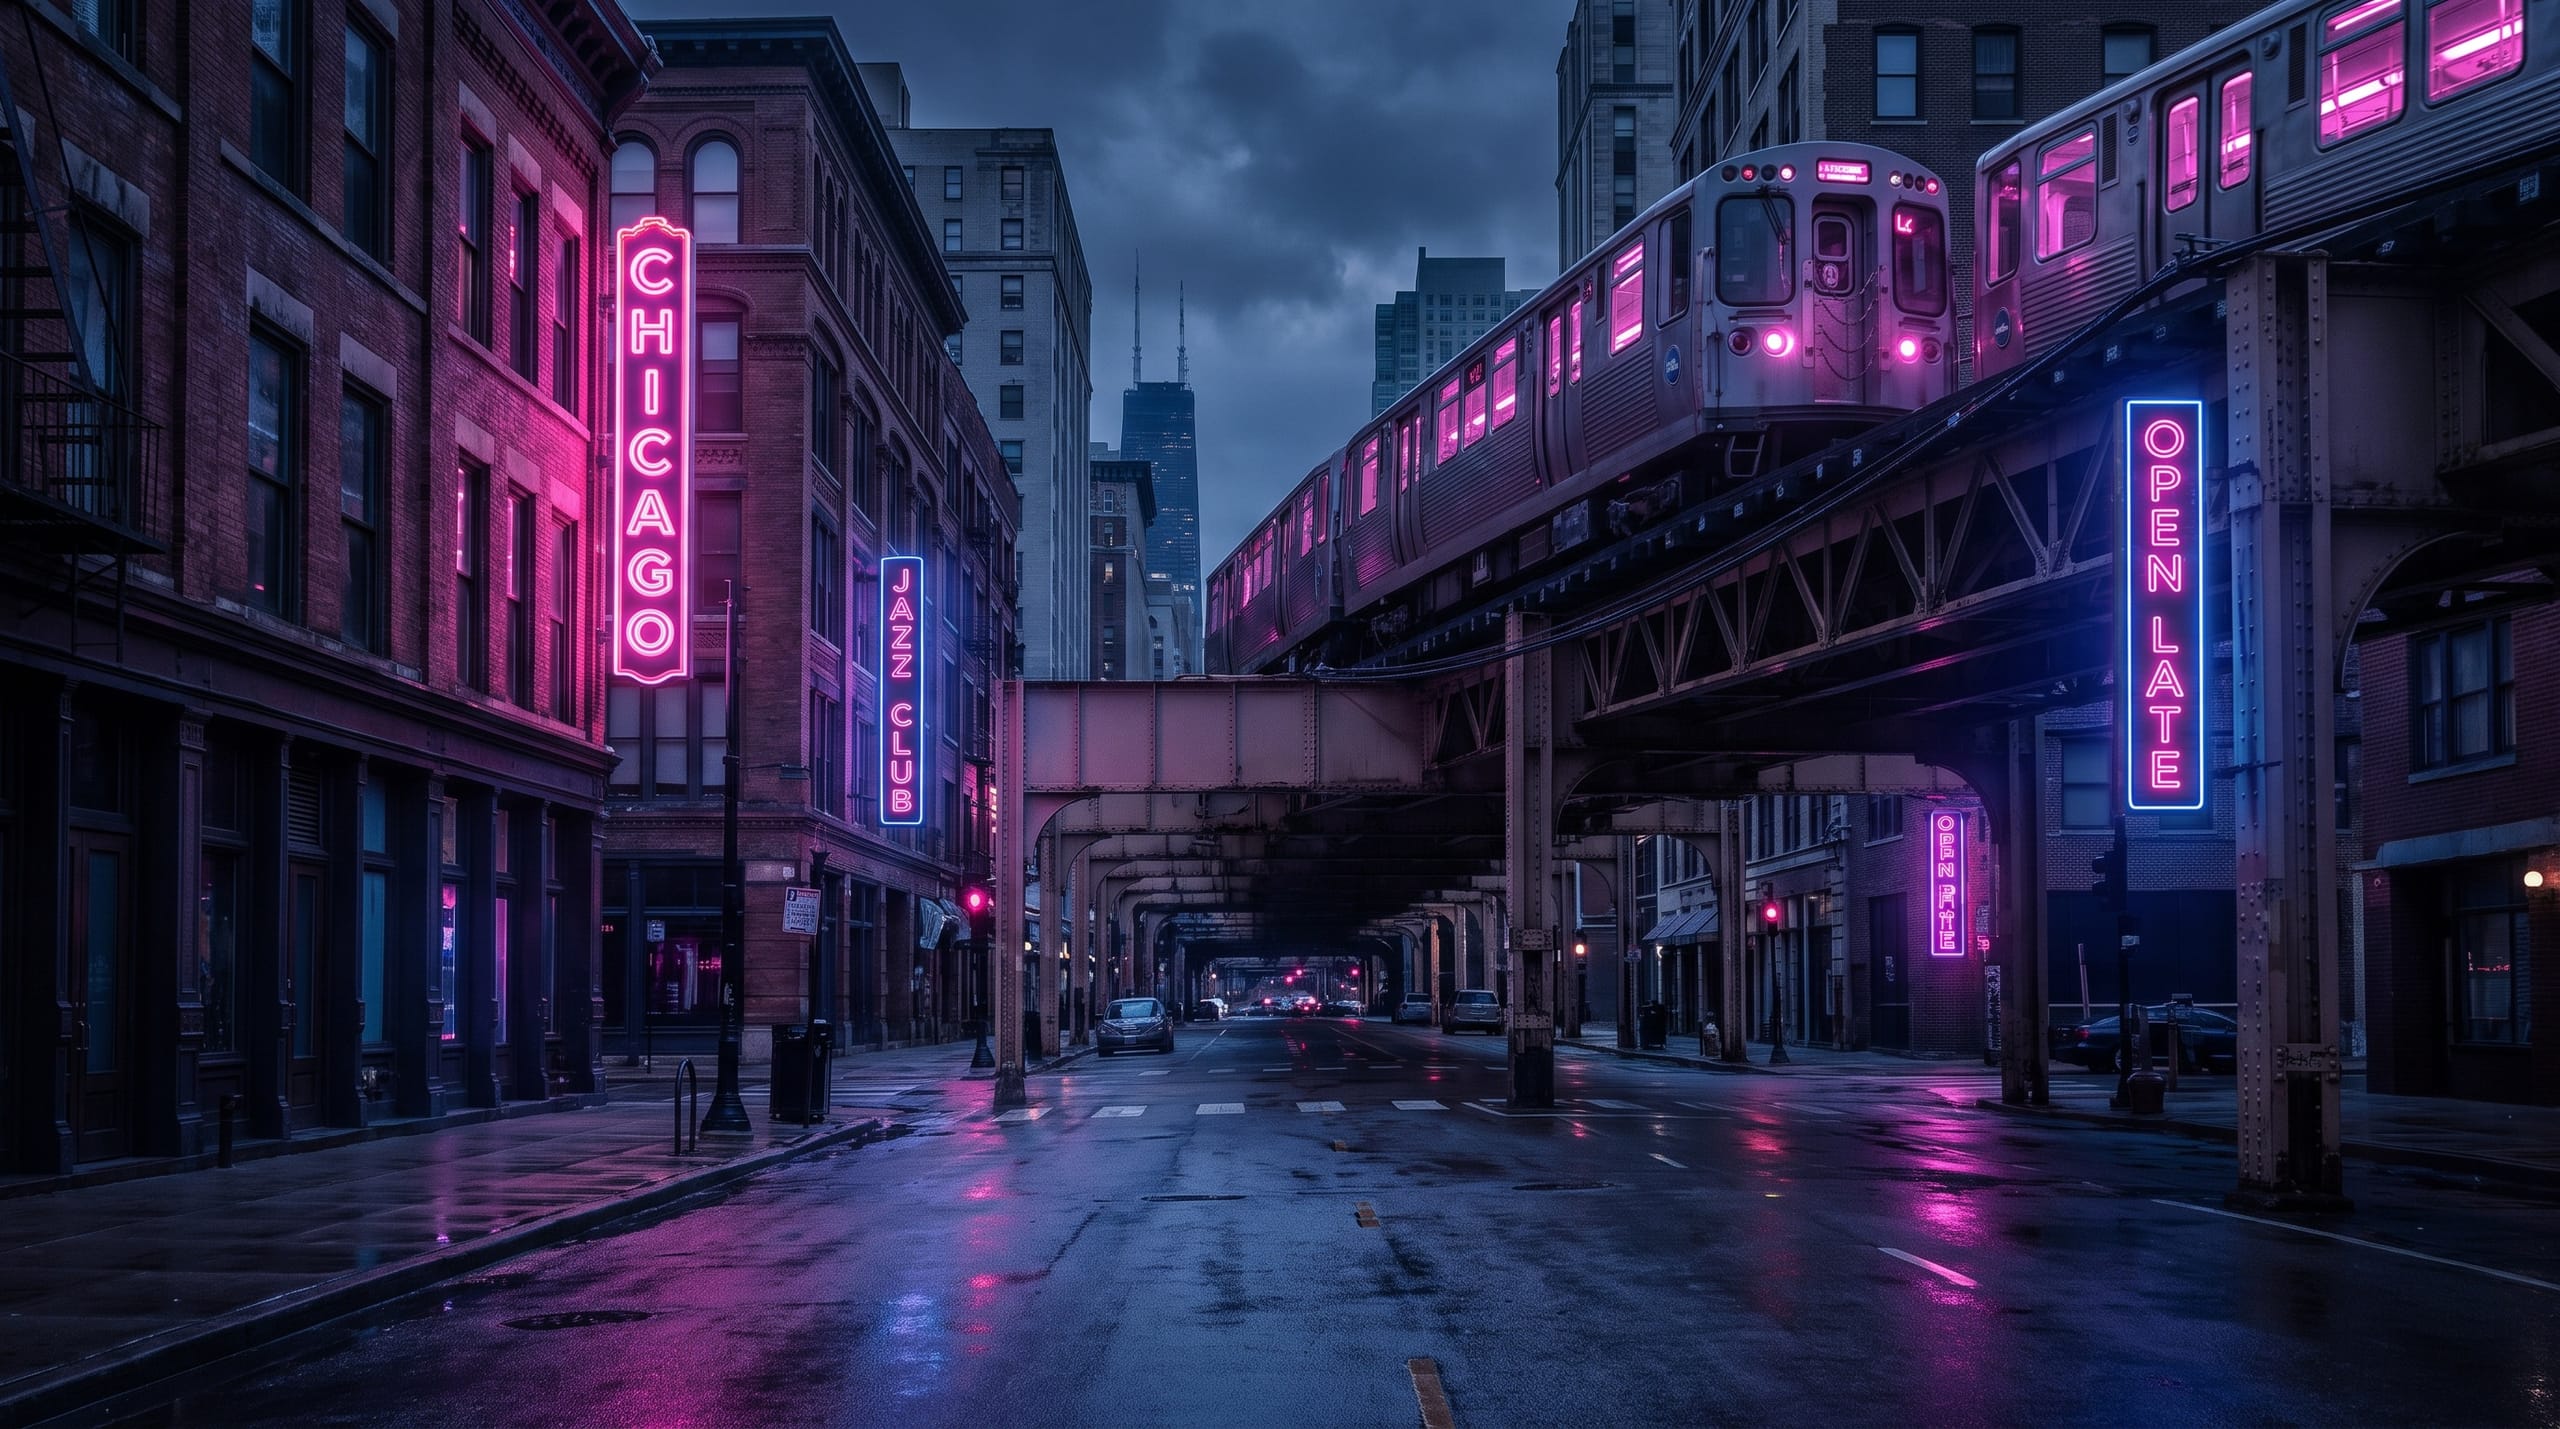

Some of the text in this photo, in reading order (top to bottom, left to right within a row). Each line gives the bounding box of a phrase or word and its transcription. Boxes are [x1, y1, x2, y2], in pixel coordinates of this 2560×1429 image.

[625, 247, 676, 657] CHICAGO
[2144, 419, 2185, 789] OPEN LATE
[889, 568, 914, 813] JAZZ CLUB
